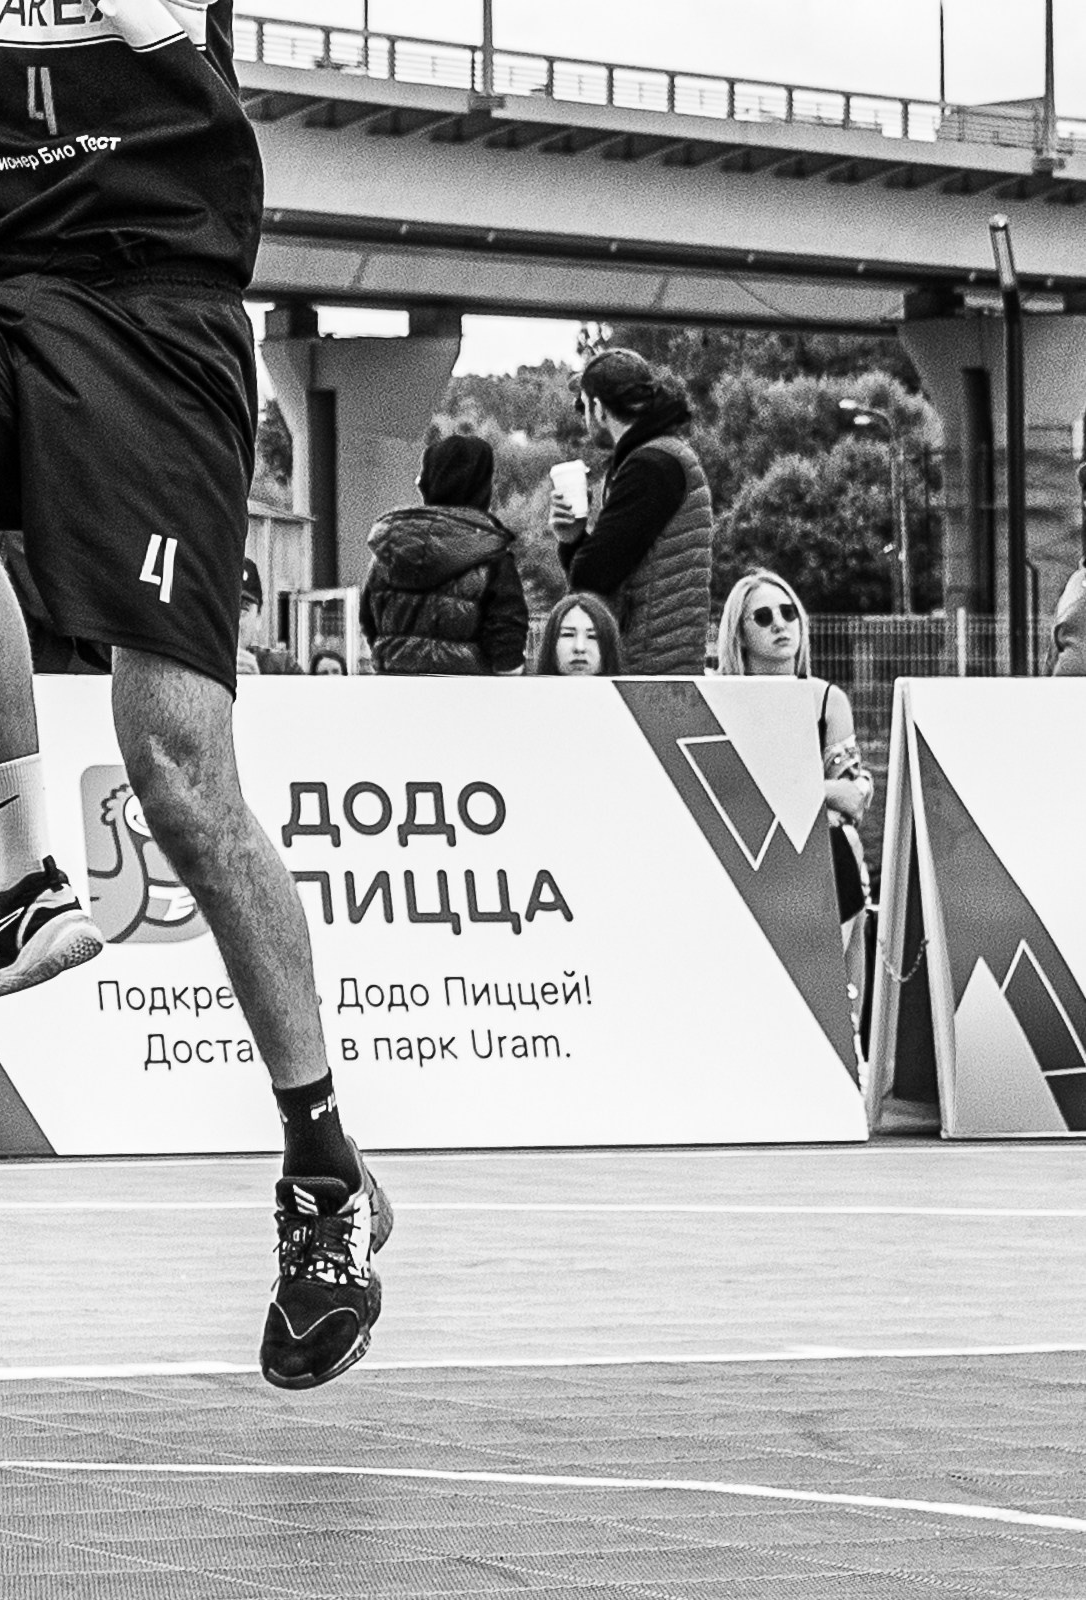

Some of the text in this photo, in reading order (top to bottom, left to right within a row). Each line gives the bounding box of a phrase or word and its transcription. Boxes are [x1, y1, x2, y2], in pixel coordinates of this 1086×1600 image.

[27, 66, 58, 135] 4
[37, 146, 76, 165] Био
[75, 134, 122, 153] Тест
[139, 533, 178, 604] 4
[281, 781, 507, 848] ДОДО
[290, 869, 574, 936] ПИЦЦА
[98, 970, 592, 1017] Подкре Додо Пиццей!
[145, 1029, 571, 1071] Доста в парк Uram.
